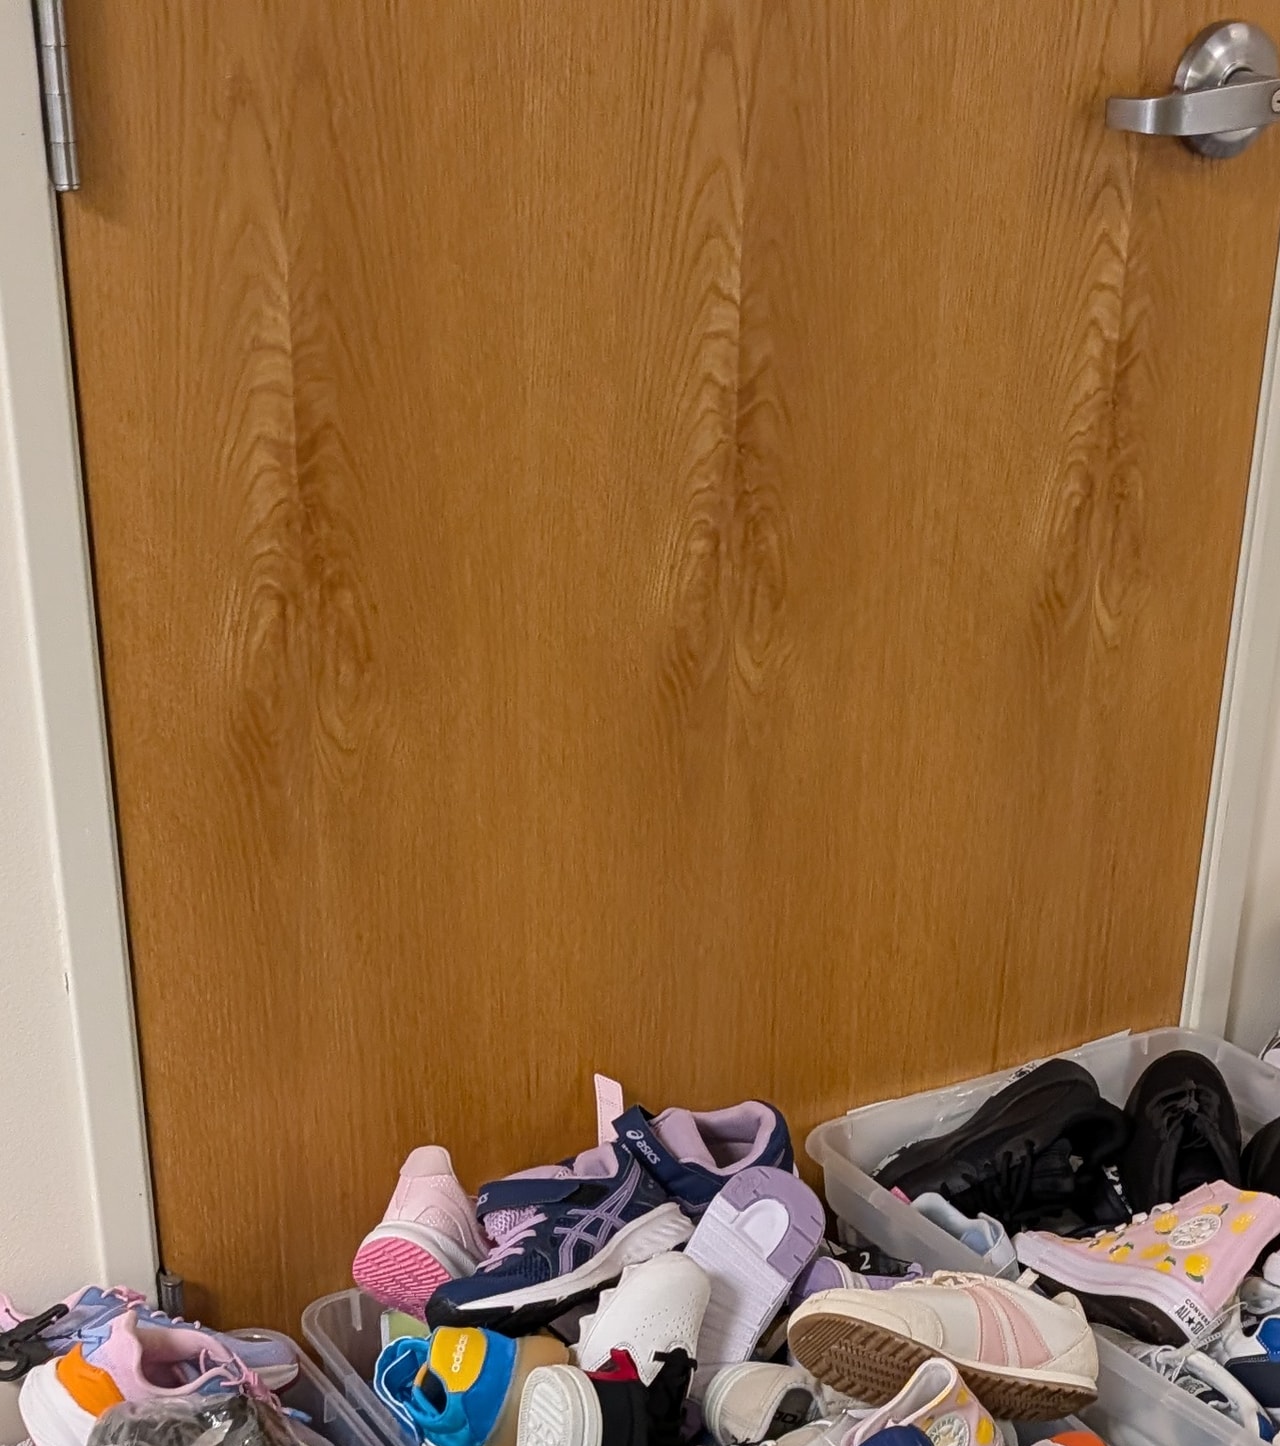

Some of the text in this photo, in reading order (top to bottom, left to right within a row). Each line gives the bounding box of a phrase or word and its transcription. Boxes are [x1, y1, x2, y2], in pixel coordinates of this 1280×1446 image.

[636, 1140, 661, 1165] asics
[860, 1251, 871, 1270] 2
[1175, 1305, 1190, 1322] ALL
[1185, 1299, 1211, 1326] CONVERS
[451, 1334, 468, 1373] adidas
